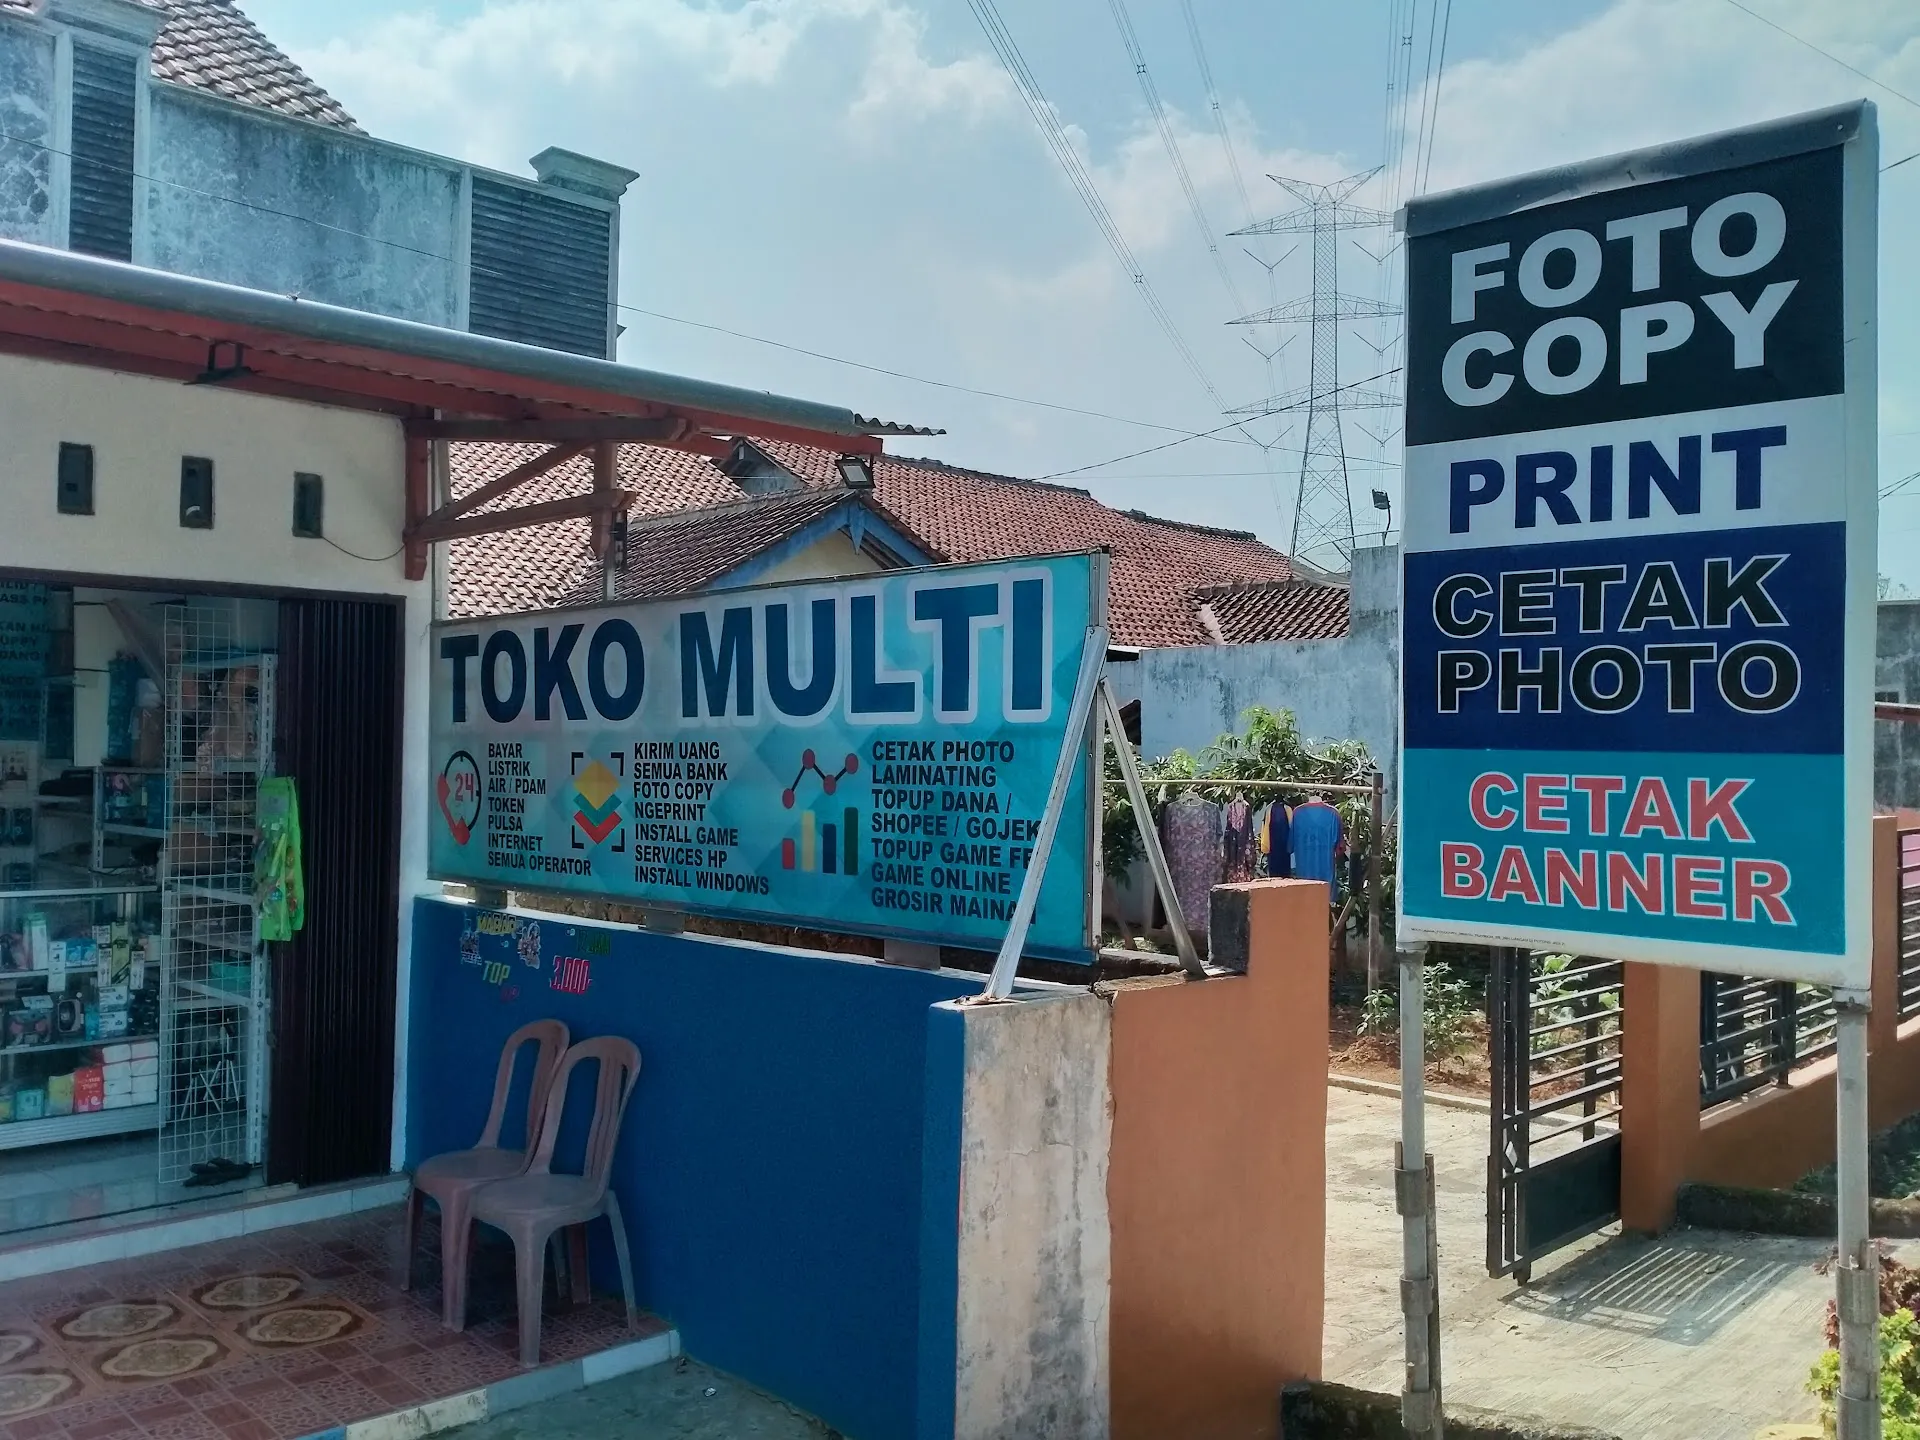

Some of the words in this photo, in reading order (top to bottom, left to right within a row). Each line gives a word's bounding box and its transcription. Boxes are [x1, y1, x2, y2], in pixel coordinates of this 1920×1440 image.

[1450, 191, 1787, 325] FOTO
[1441, 279, 1799, 407] COPY
[1449, 425, 1787, 534] PRINT
[1433, 554, 1791, 639] CETAK
[441, 619, 645, 723] TOKO
[680, 579, 1043, 718] MULTI
[1437, 640, 1802, 715] PHOTO
[488, 743, 522, 759] BAYAR
[634, 742, 674, 760] KIRIM
[679, 742, 720, 760] UANG
[872, 741, 936, 761] CETAK
[942, 741, 1015, 762] PHOTO
[488, 761, 531, 777] LISTRIK
[634, 763, 683, 780] SEMUA
[686, 763, 728, 781] BANK
[872, 766, 996, 787] LAMINATING
[455, 774, 474, 801] 24
[488, 779, 506, 794] AIR
[508, 780, 513, 795] /
[514, 779, 546, 795] PDAM
[634, 782, 671, 799] FOTO
[674, 783, 714, 801] COPY
[488, 797, 525, 814] TOKEN
[634, 802, 706, 822] NGEPRINT
[872, 789, 935, 811] TOPUP
[941, 791, 999, 813] DANA
[1005, 793, 1012, 815] /
[1468, 771, 1756, 844] CETAK
[488, 816, 523, 832] PULSA
[635, 824, 692, 844] INSTALL
[696, 827, 739, 847] GAME
[872, 814, 947, 836] SHOPEE
[953, 816, 960, 838] /
[966, 816, 1041, 841] GOJEK
[488, 834, 543, 852] INTERNET
[872, 838, 933, 862] TOPUP
[940, 842, 1001, 867] GAME
[488, 852, 526, 868] SEMUA
[529, 857, 592, 876] OPERATOR
[635, 845, 703, 867] SERVICES
[708, 850, 728, 868] HP
[635, 867, 692, 888] INSTALL
[696, 871, 769, 895] WINDOWS
[872, 863, 924, 887] GAME
[930, 867, 1011, 895] ONLINE
[1440, 841, 1797, 926] BANNER
[872, 887, 942, 914] GROSIR
[482, 959, 511, 985] TOP
